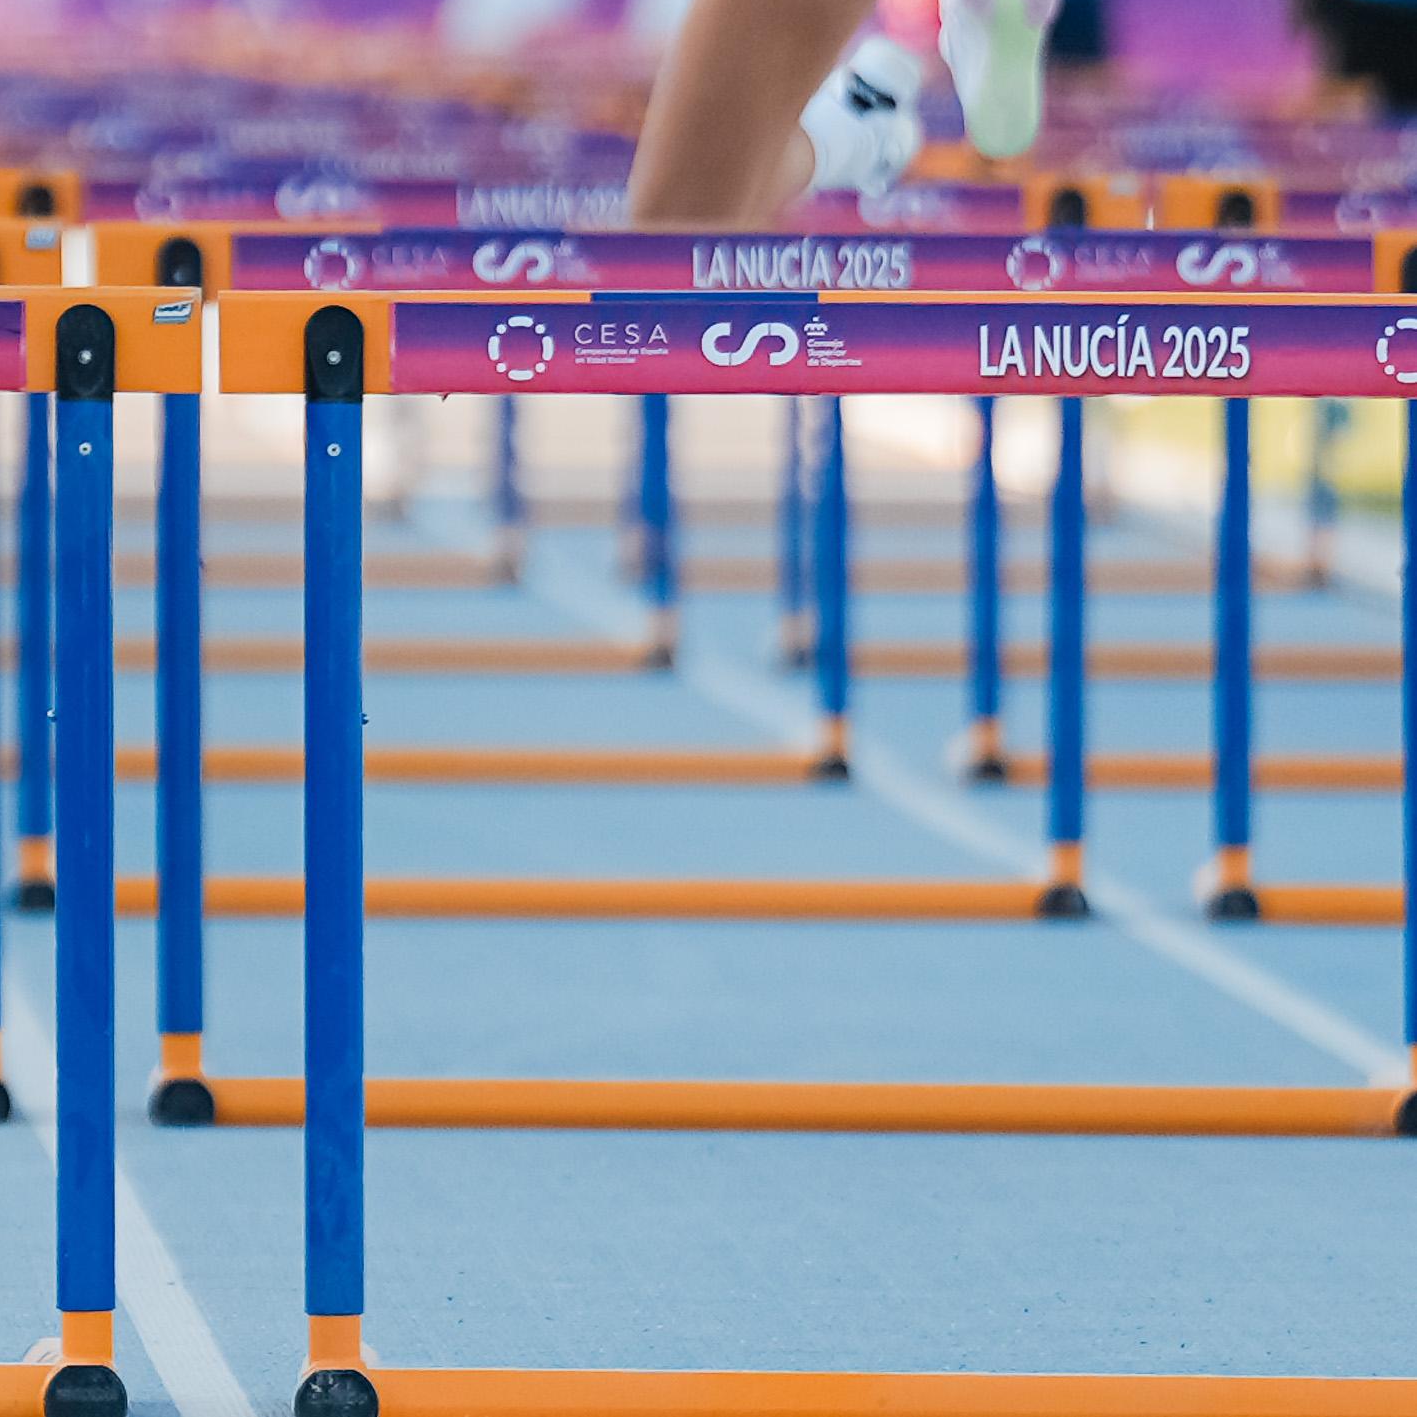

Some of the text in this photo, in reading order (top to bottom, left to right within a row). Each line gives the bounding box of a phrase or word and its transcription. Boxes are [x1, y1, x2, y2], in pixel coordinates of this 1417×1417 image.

[692, 236, 910, 288] LA NUCÍA 2025
[574, 323, 669, 345] CESA
[979, 314, 1251, 379] LA NUCÍA 2025
